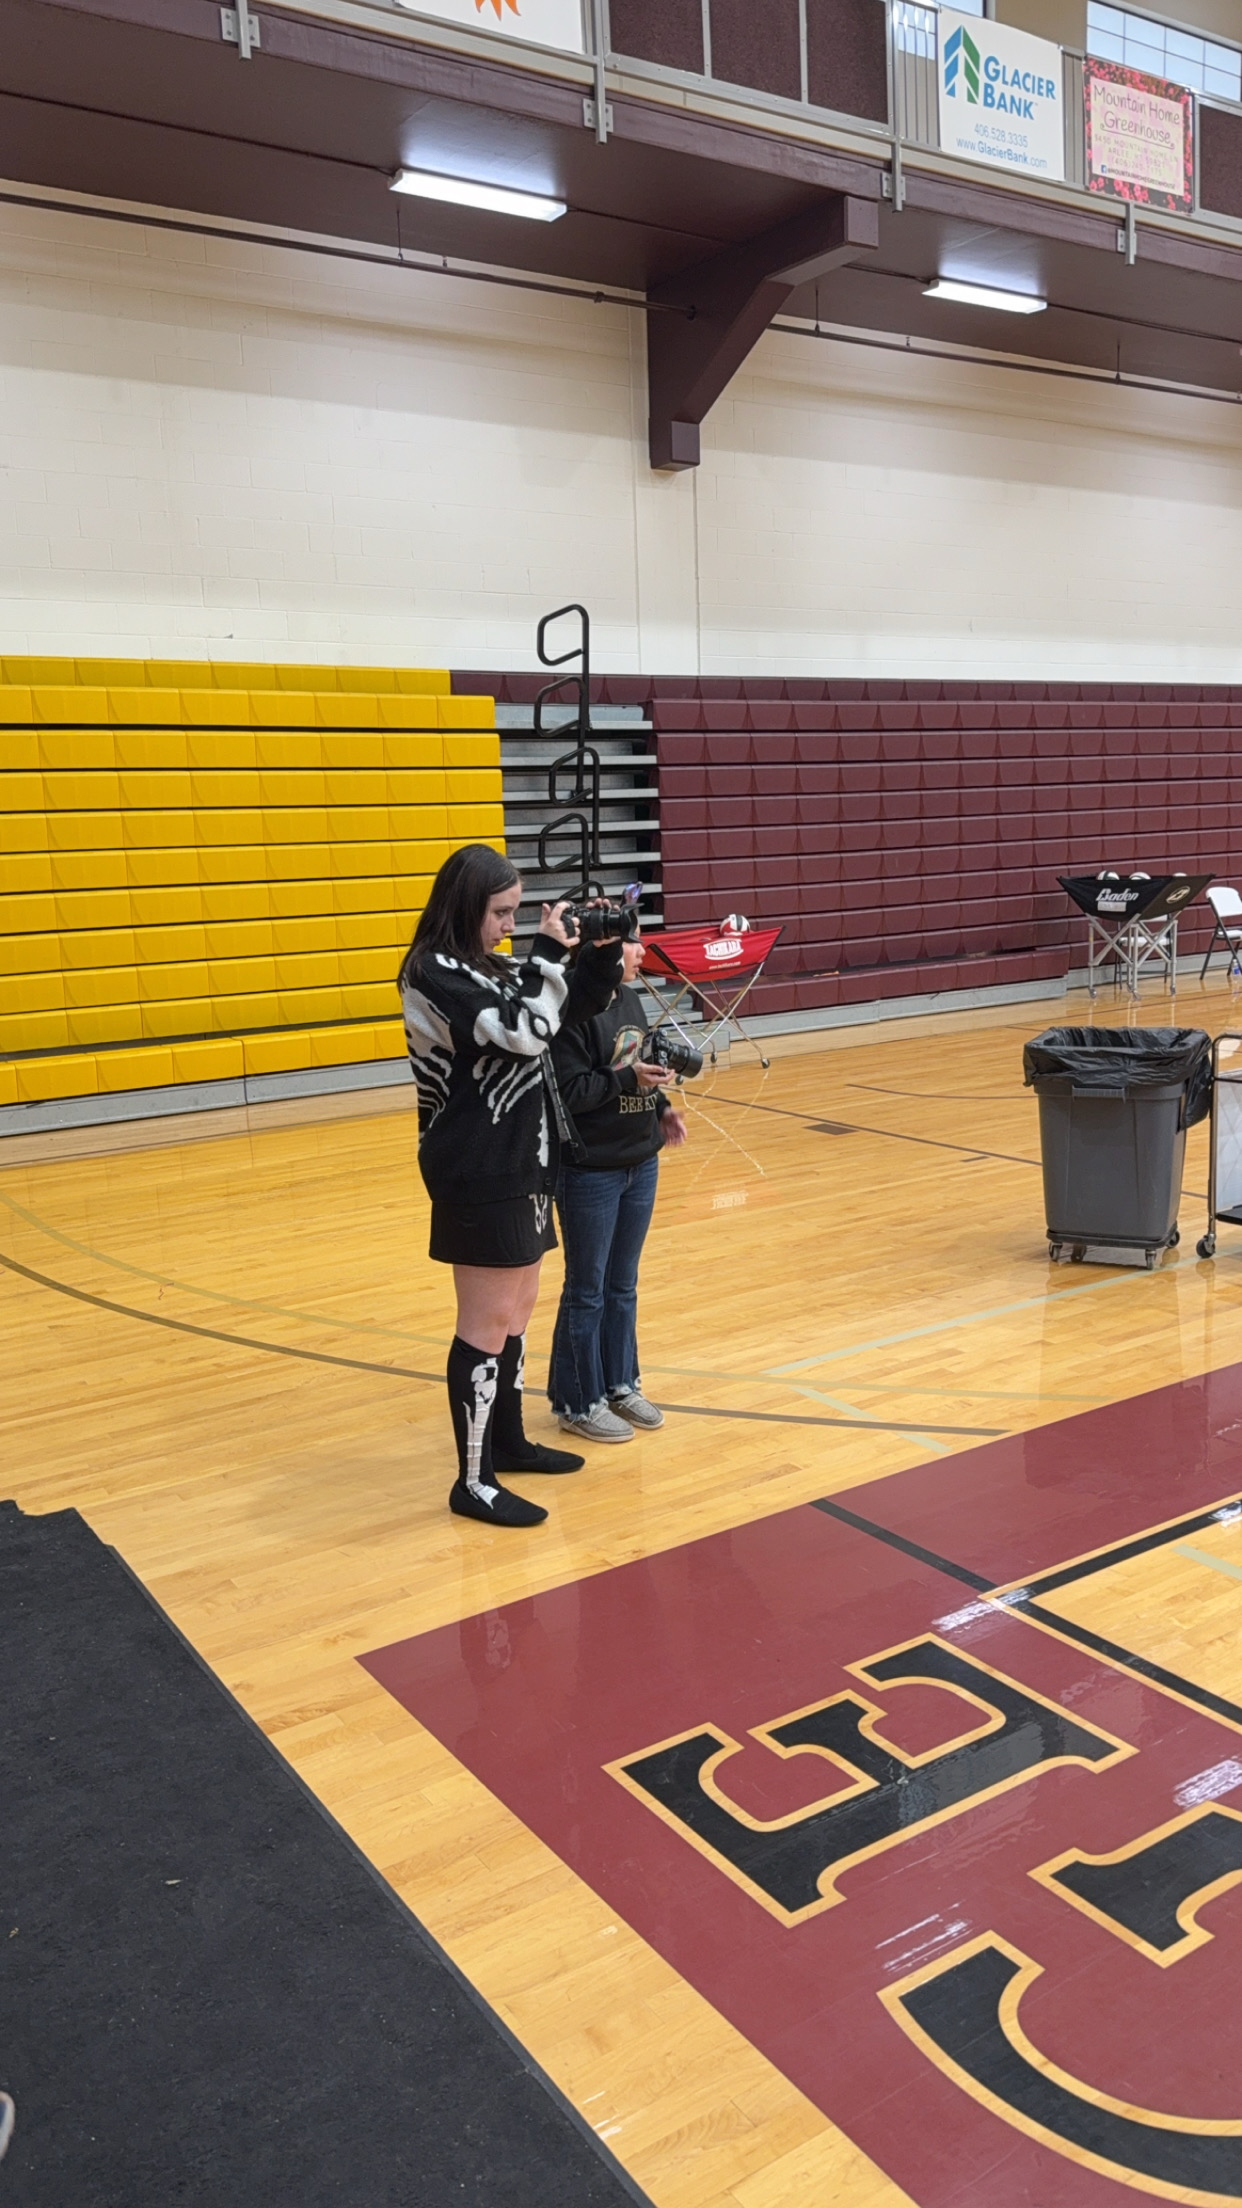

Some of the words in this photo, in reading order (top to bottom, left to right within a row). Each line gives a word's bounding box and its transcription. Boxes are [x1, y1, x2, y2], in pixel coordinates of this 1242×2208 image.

[984, 55, 1056, 100] GLACIER
[983, 82, 1035, 121] BANK
[1094, 84, 1147, 116] Mountain
[1149, 100, 1180, 125] Home
[974, 122, 1029, 148] 406.528.3335
[1104, 110, 1171, 145] Greenhouse
[956, 137, 1048, 169] www.GlacierBank.com
[1096, 887, 1140, 901] Baden
[619, 1095, 643, 1114] BEE
